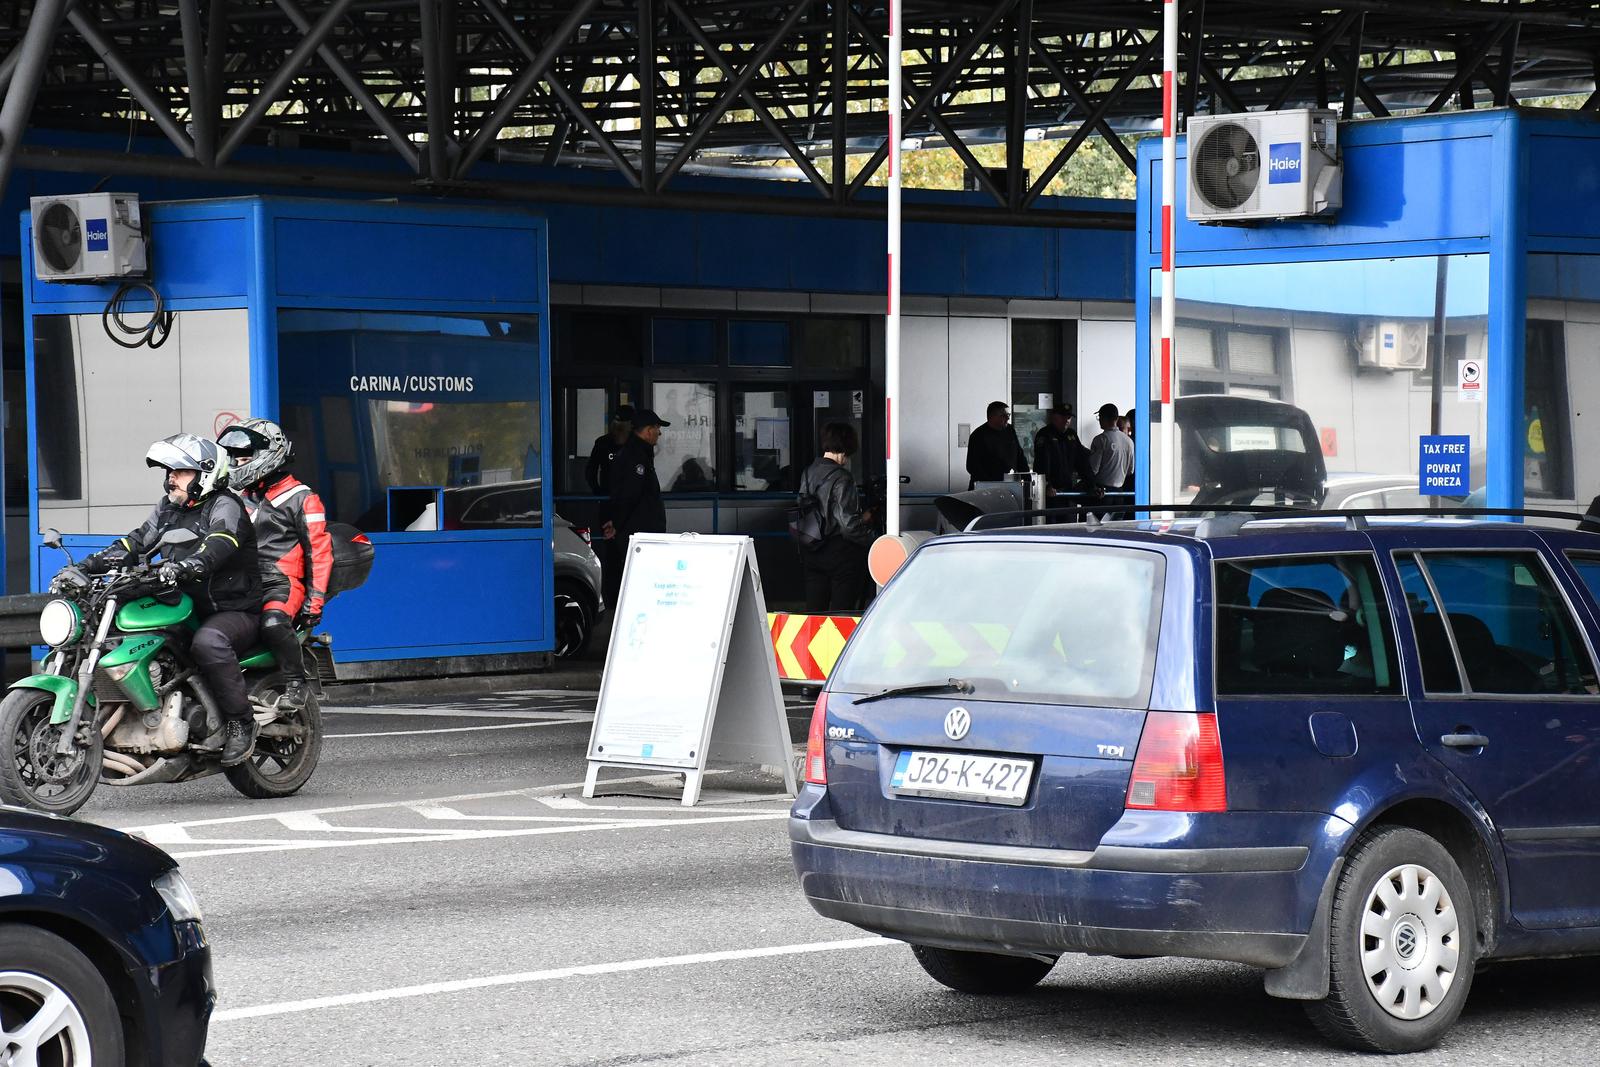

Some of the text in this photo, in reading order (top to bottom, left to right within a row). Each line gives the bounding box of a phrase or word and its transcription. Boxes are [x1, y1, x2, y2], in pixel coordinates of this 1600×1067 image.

[1269, 157, 1301, 171] Haier
[87, 230, 107, 241] Haier
[350, 375, 474, 393] CARINA/CUSTOMS
[1423, 444, 1466, 454] TAX FREE
[1426, 463, 1462, 473] POVRAT
[1426, 477, 1462, 487] POREZA
[828, 726, 855, 738] GOLF
[1096, 744, 1125, 758] TDI
[908, 756, 1028, 792] J26-K-427
